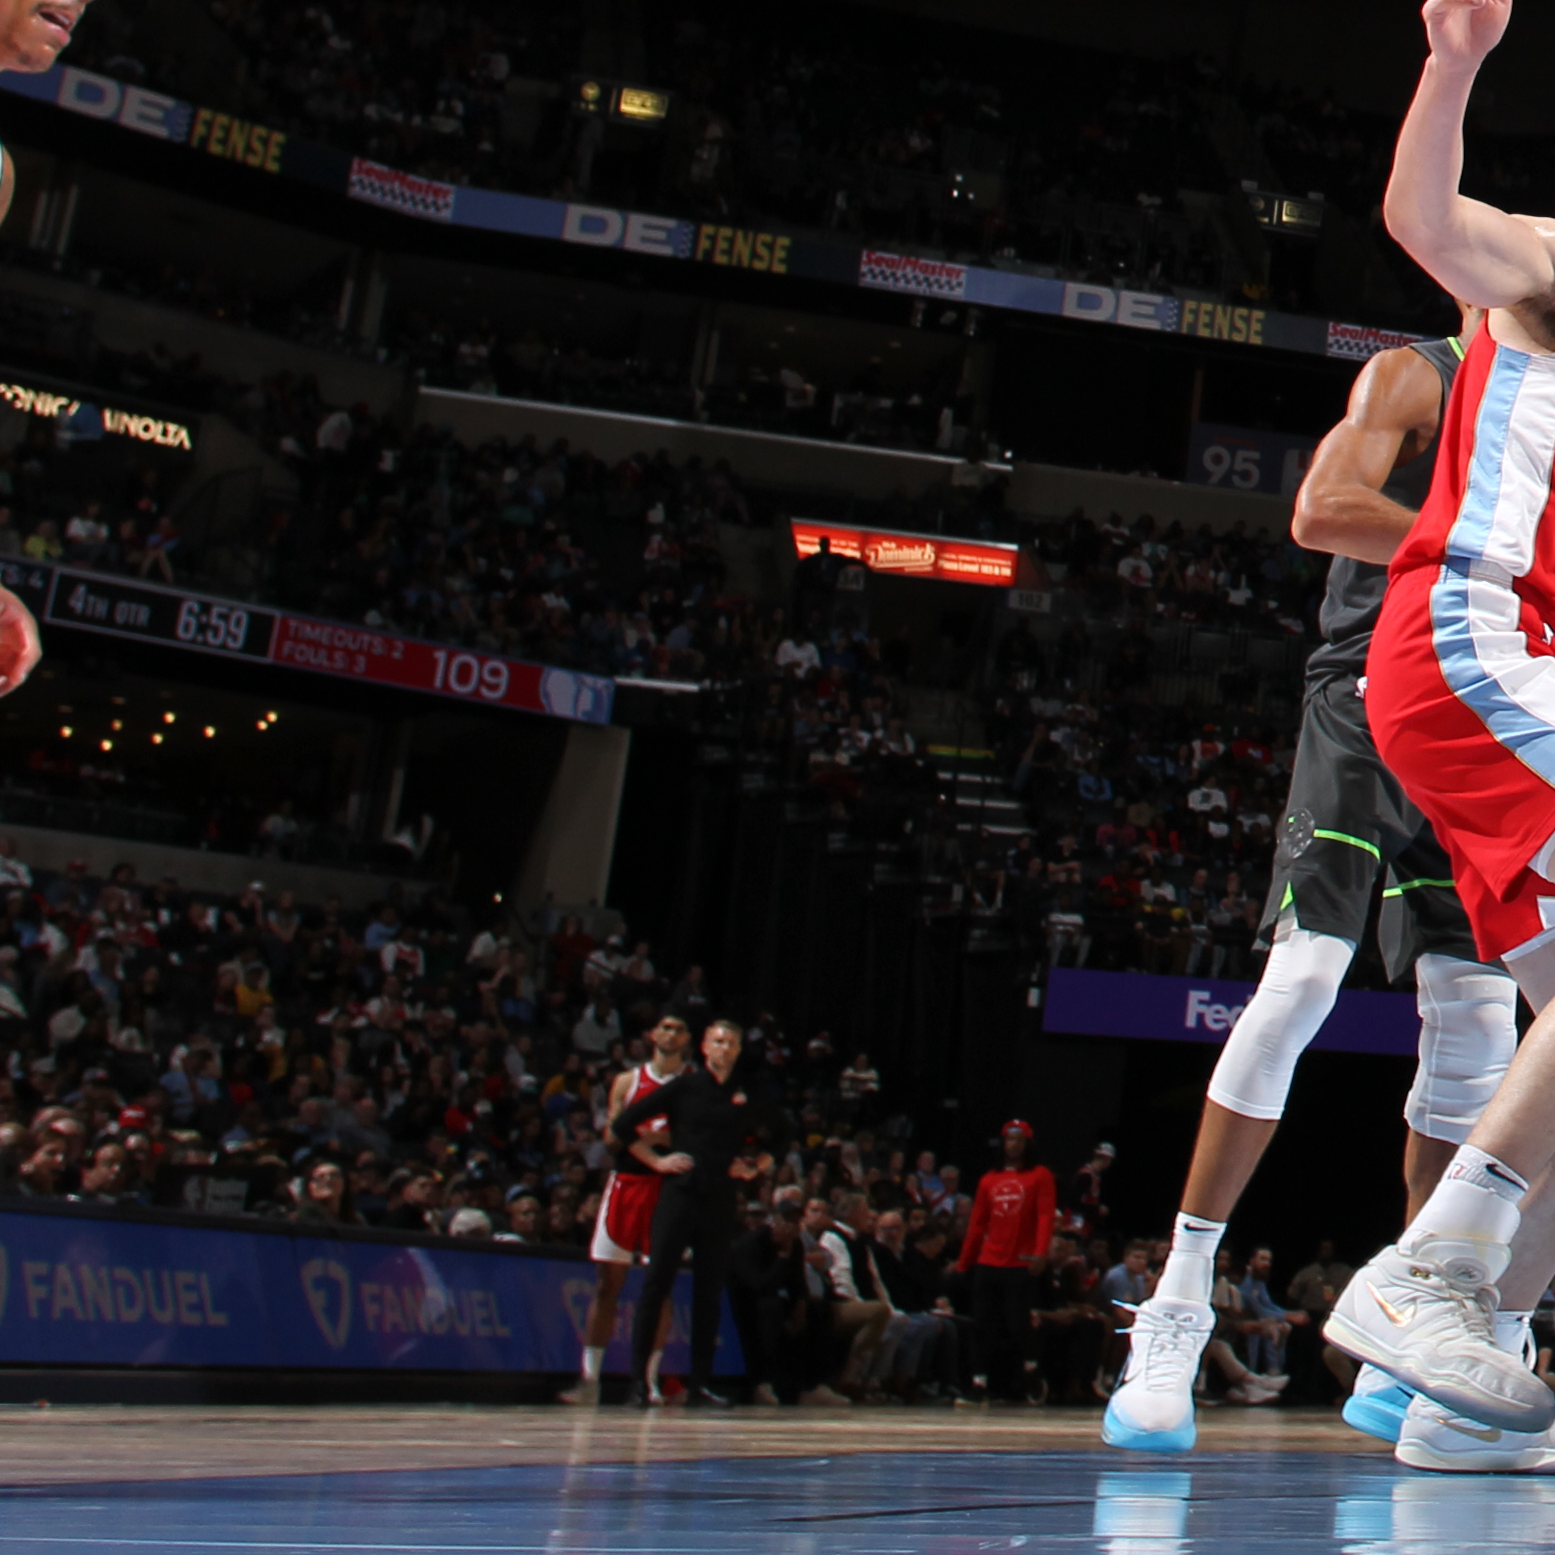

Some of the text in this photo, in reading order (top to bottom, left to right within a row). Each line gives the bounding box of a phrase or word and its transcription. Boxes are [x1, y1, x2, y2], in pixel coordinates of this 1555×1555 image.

[57, 68, 287, 173] DE FENSE
[562, 203, 791, 273] DE FENSE
[862, 250, 966, 280] SealMaster
[1062, 283, 1265, 344] DE FENSE
[1203, 445, 1261, 489] 95
[67, 583, 110, 620] 4TH
[175, 600, 250, 650] 6:59
[391, 641, 405, 660] 2
[432, 651, 510, 702] 109
[23, 1261, 229, 1326] FANDUEL
[362, 1281, 511, 1338] FANDUEL
